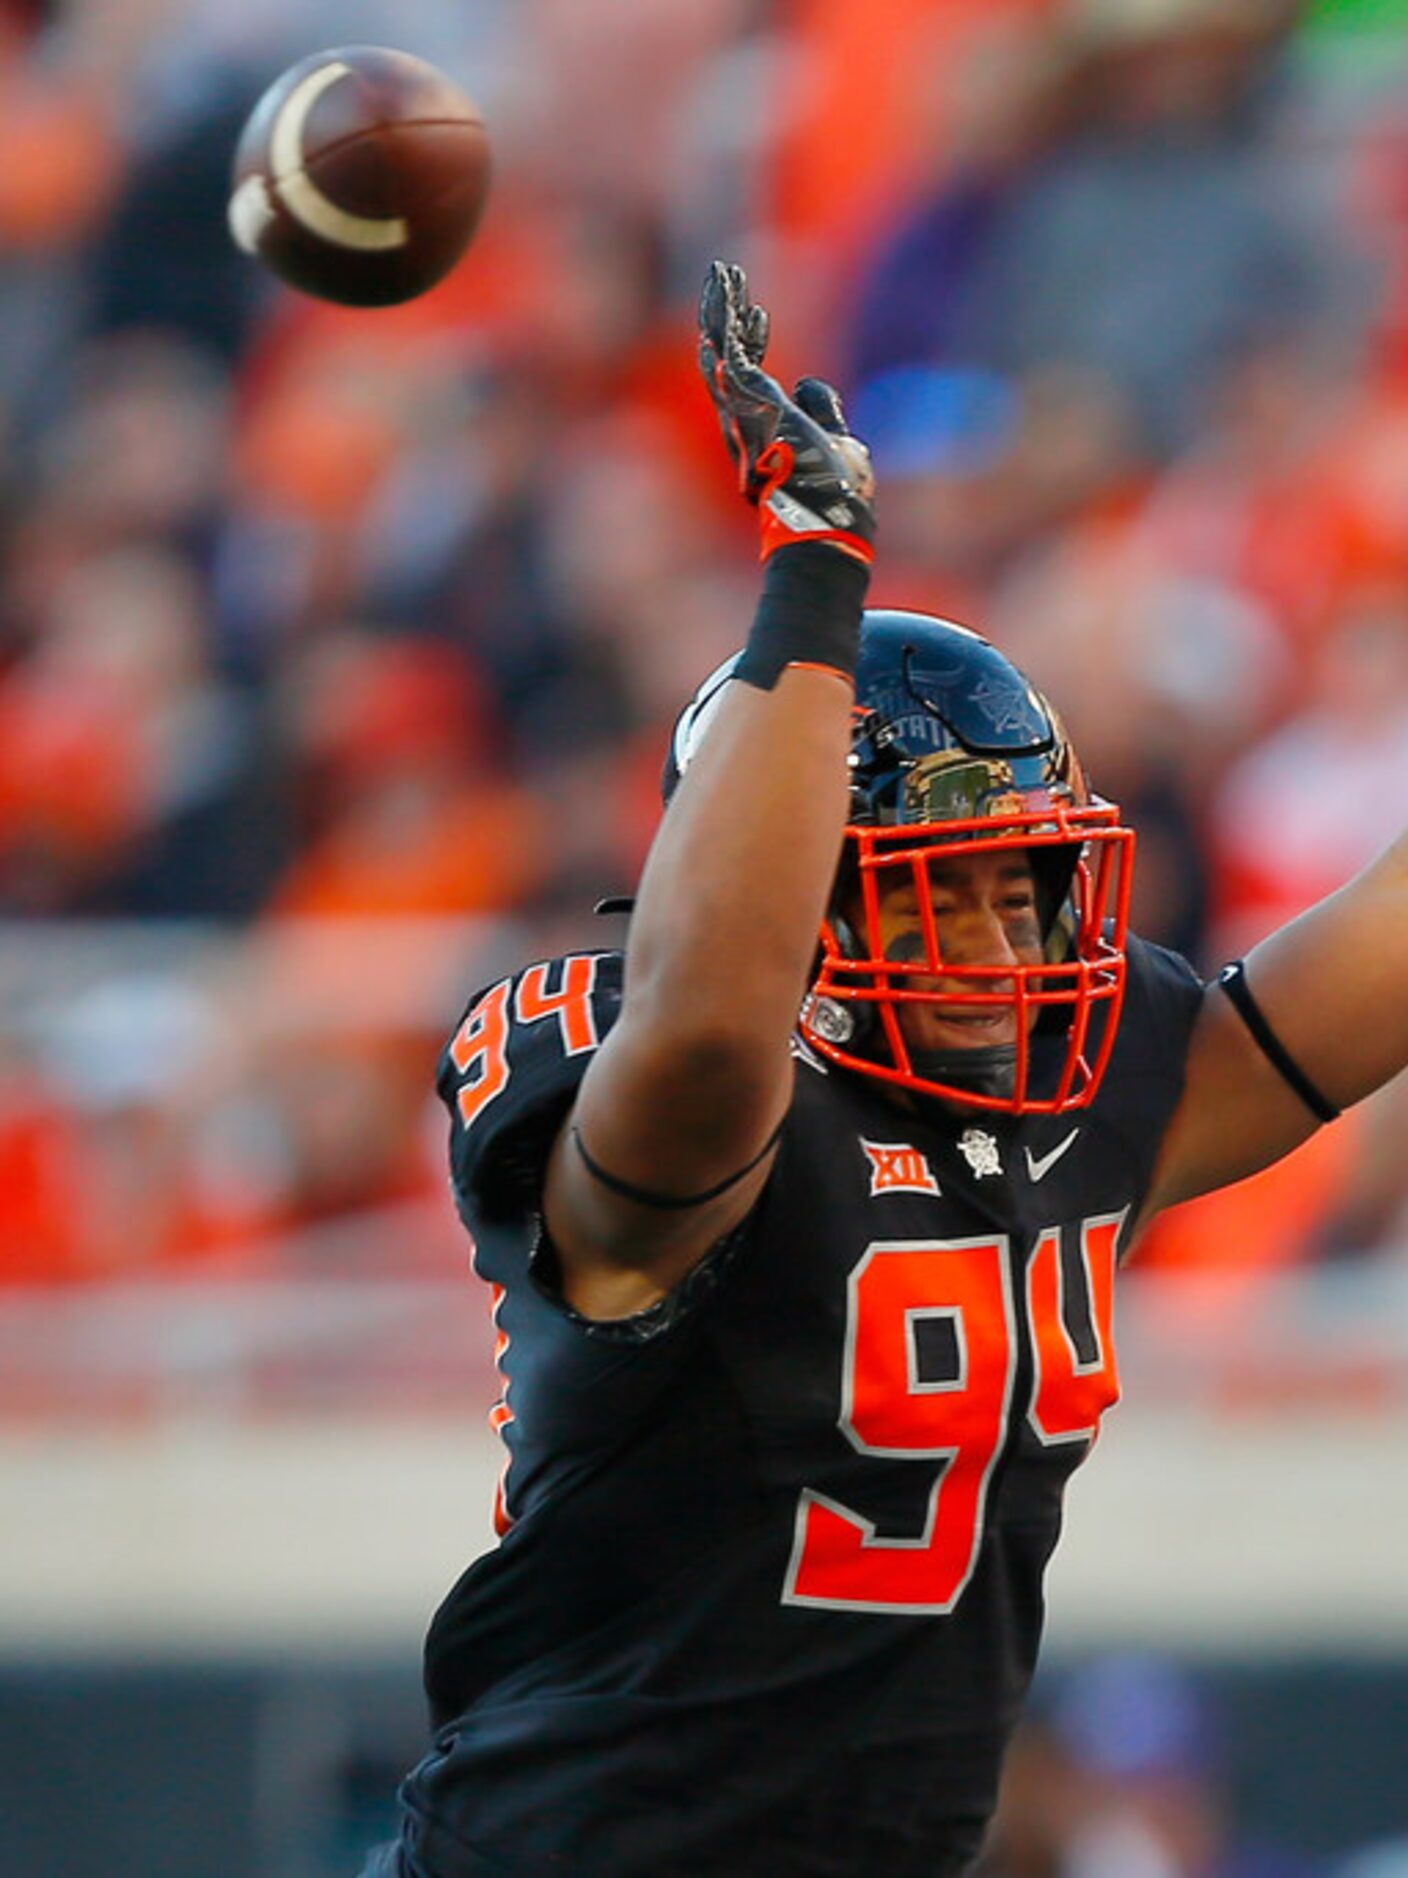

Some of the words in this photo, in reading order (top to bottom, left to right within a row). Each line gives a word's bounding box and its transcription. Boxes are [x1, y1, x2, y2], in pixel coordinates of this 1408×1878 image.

[449, 953, 603, 1130] 94
[859, 1137, 941, 1196] XII
[780, 1204, 1122, 1615] 94
